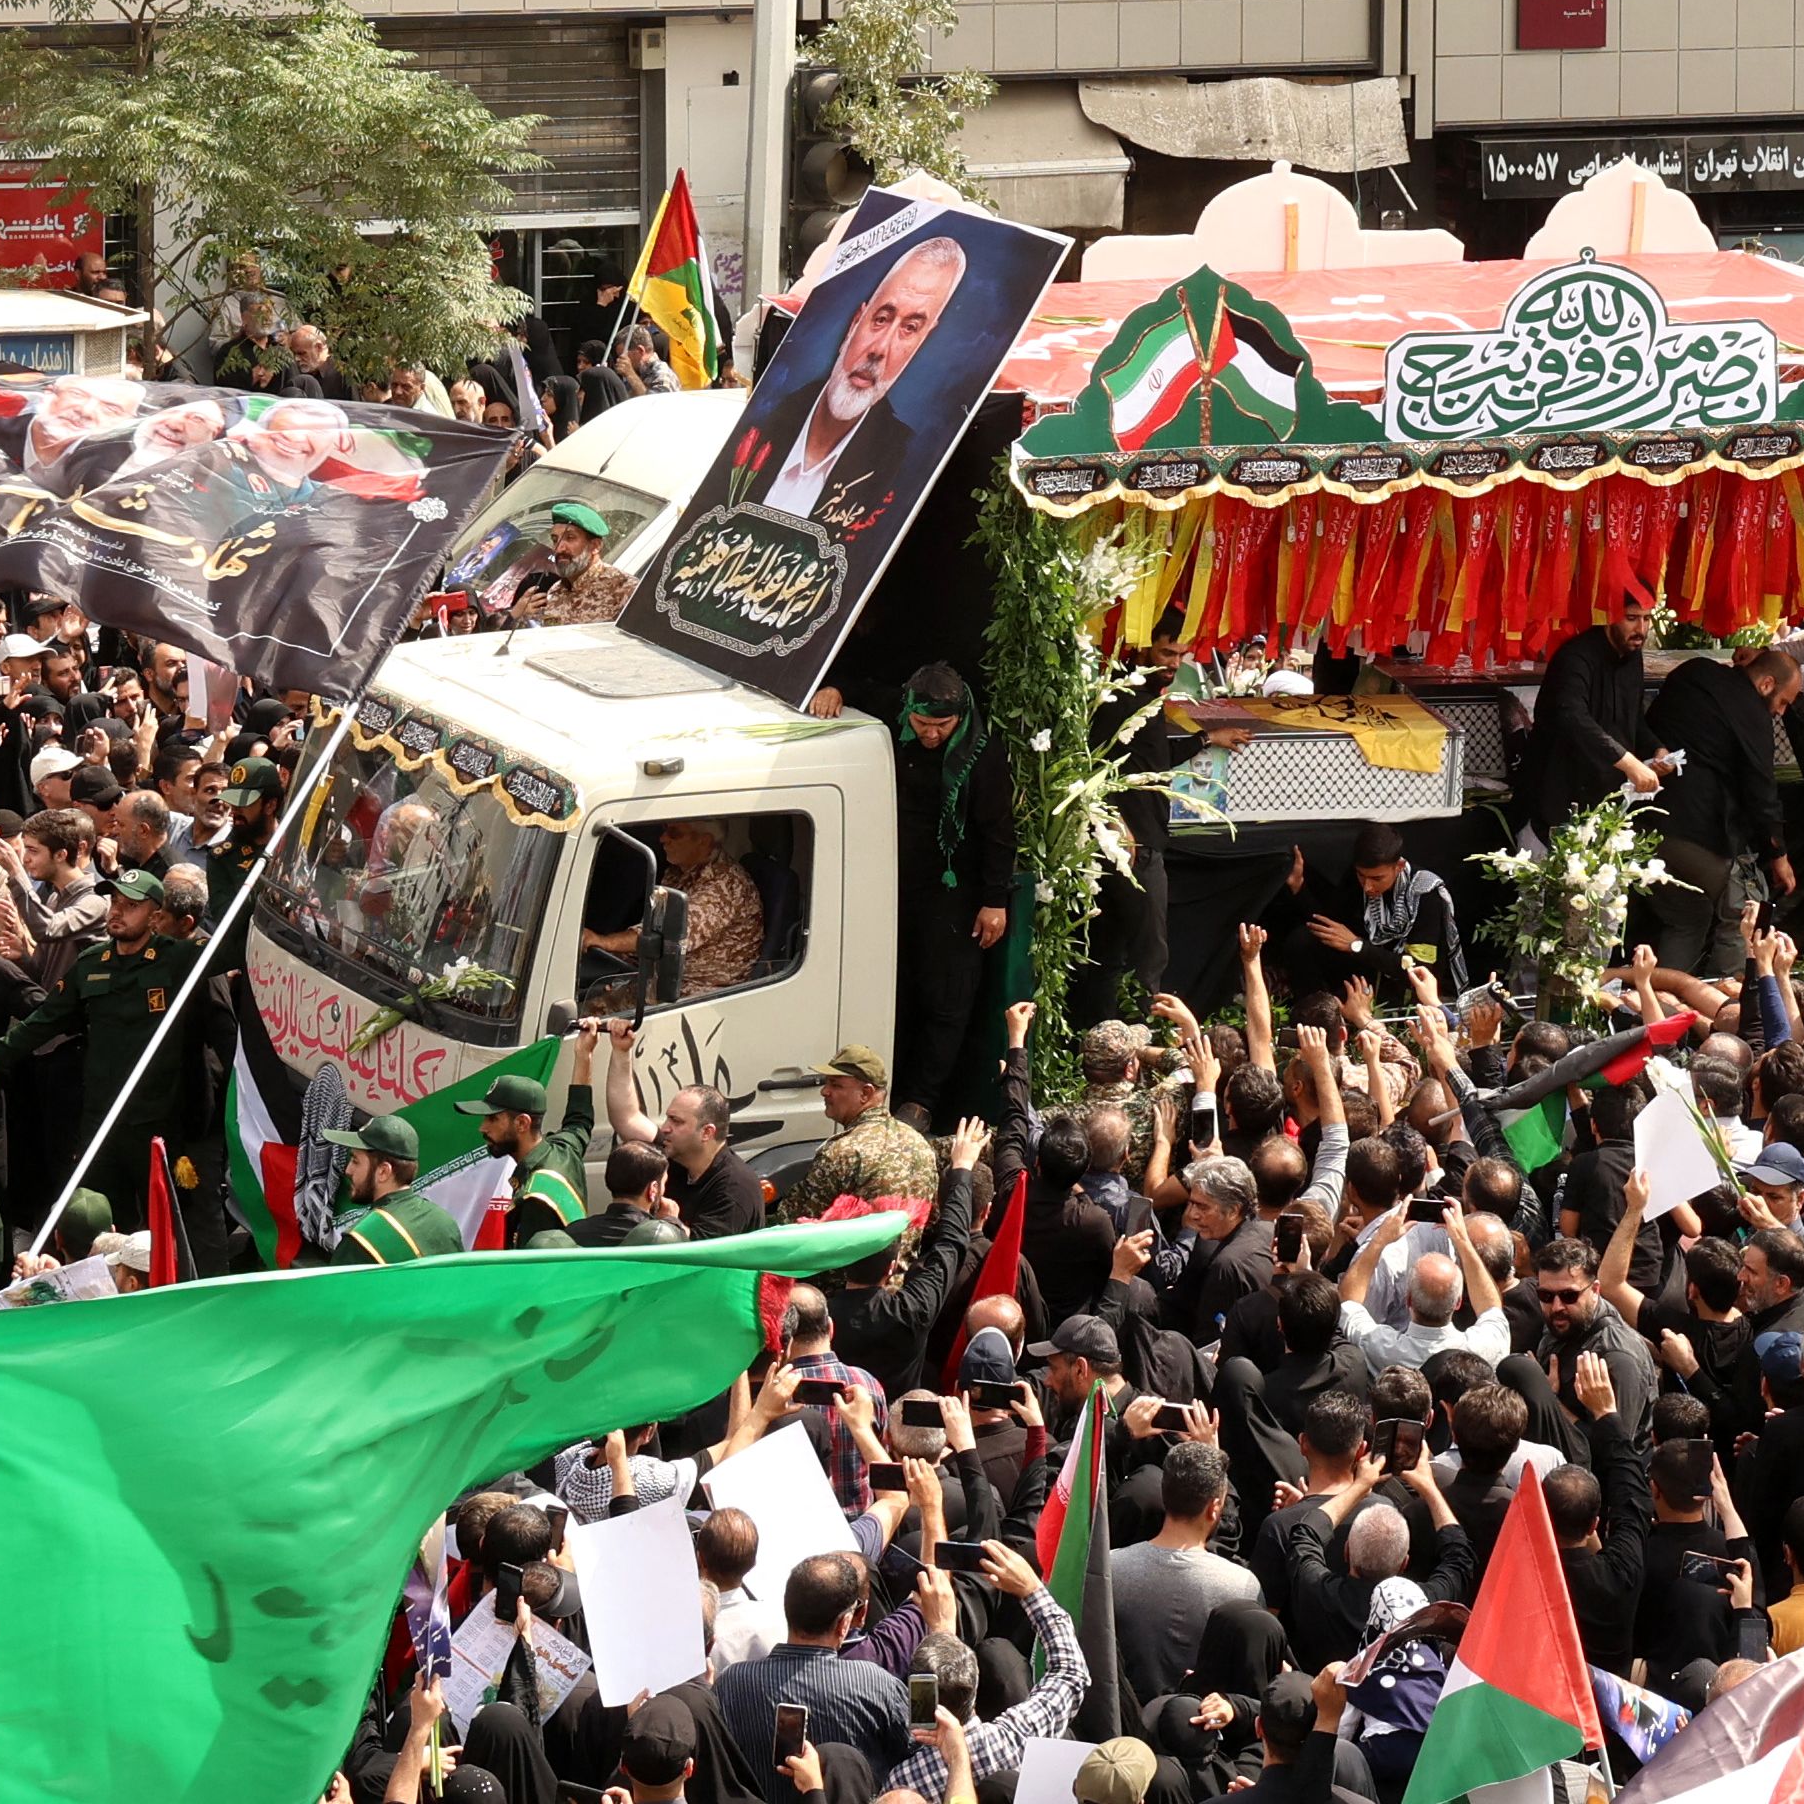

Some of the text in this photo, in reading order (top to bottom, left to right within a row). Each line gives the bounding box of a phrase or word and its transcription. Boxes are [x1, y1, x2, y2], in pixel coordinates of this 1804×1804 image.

[1487, 151, 1560, 184] ۱۵۰۰۰۵۷
[1693, 149, 1739, 183] تهران
[1741, 147, 1790, 181] انقلاب
